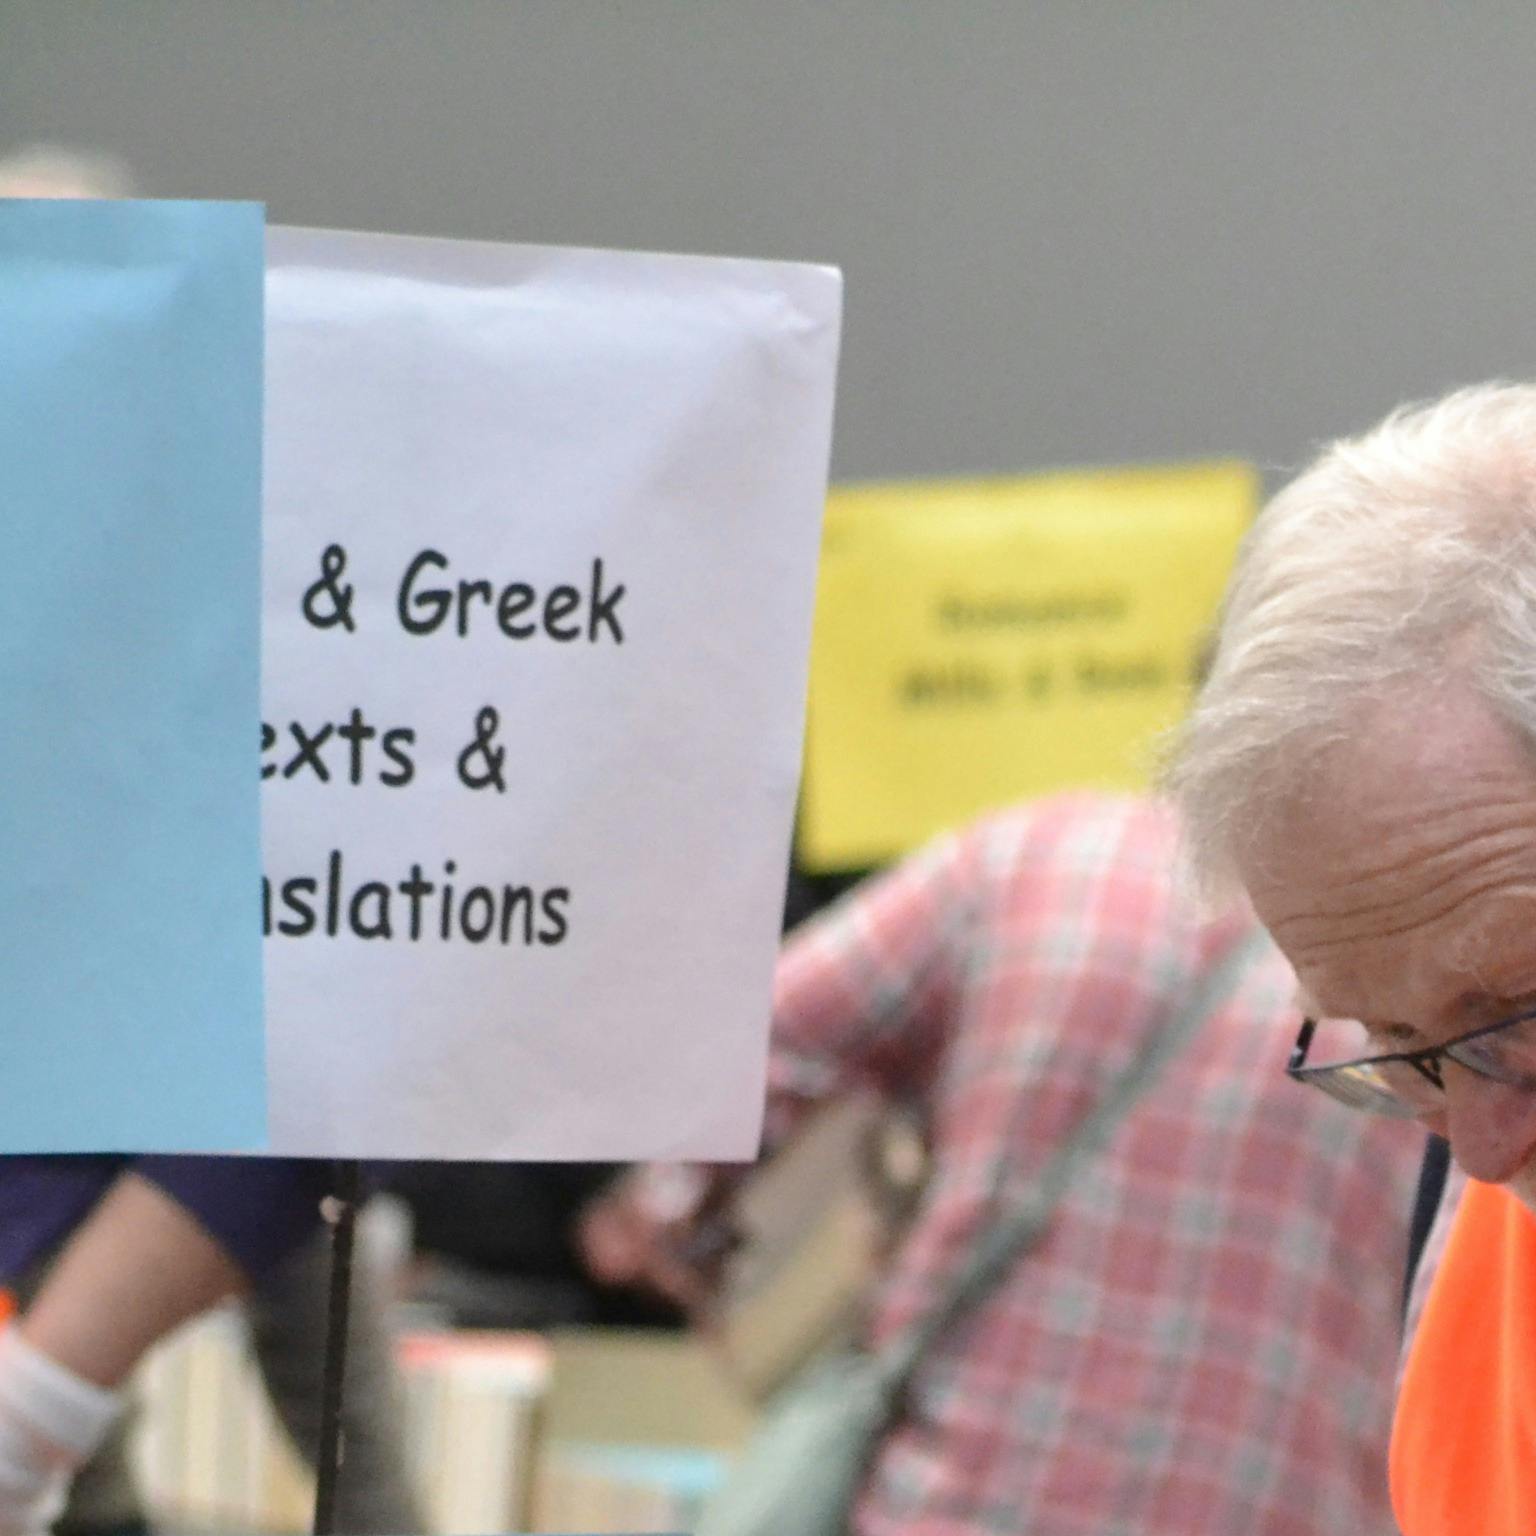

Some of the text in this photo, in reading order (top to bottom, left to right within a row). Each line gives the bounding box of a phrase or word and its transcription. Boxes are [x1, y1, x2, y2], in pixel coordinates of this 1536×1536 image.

[302, 543, 626, 646] & Greek
[261, 705, 506, 793] xts &
[261, 849, 571, 946] slations
